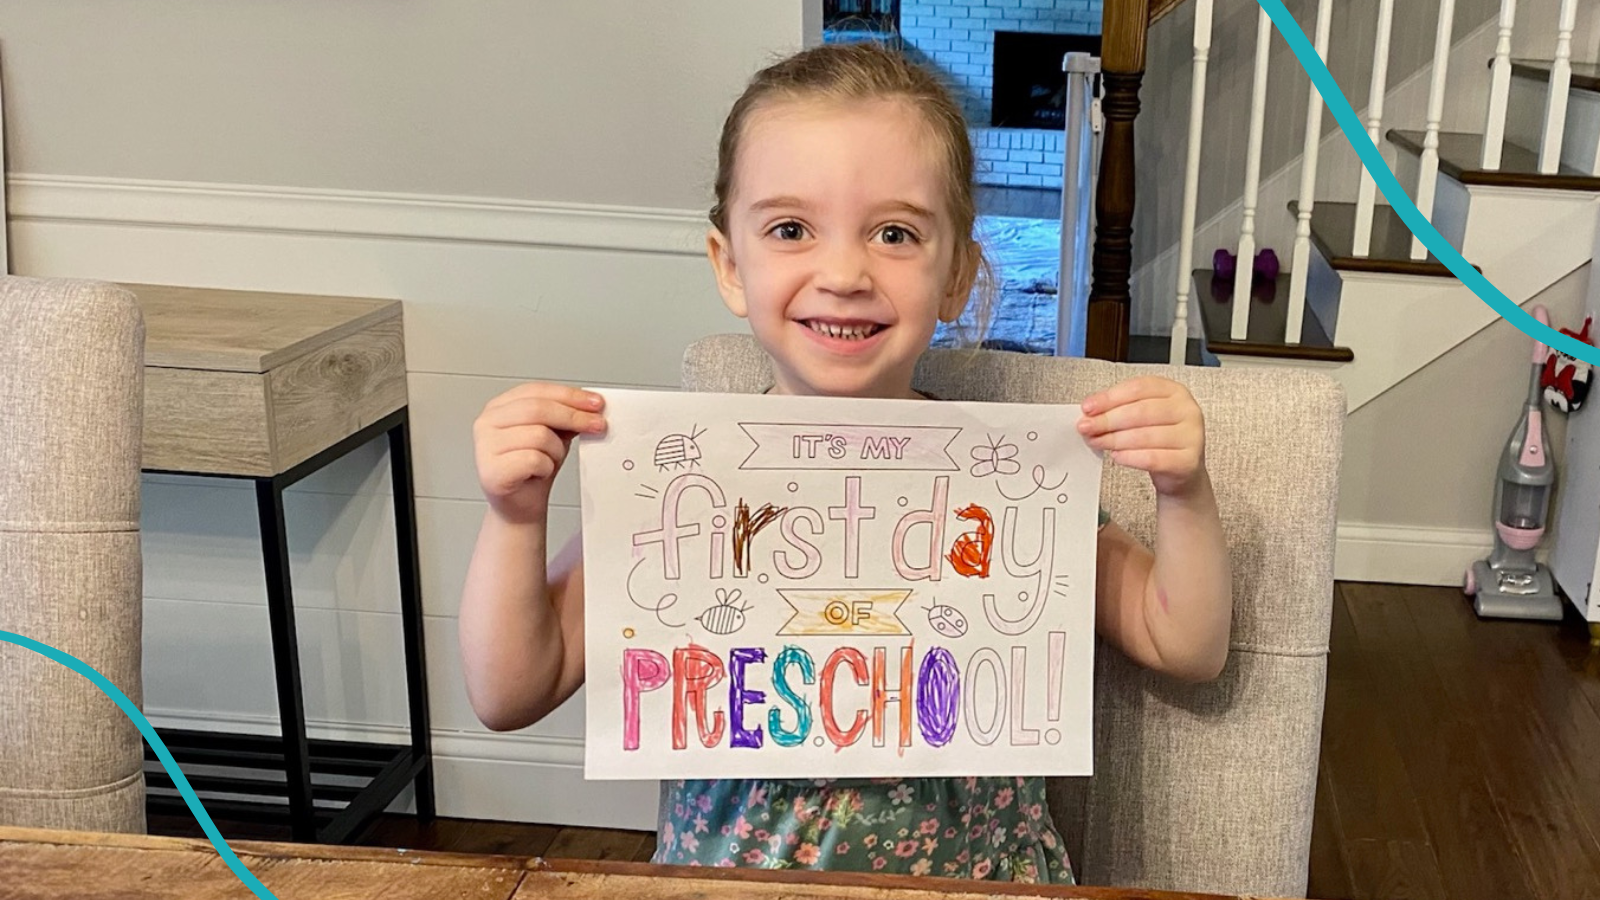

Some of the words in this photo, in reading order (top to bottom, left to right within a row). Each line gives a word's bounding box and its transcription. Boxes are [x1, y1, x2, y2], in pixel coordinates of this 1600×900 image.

[792, 433, 847, 460] IT'S
[860, 436, 912, 460] MY
[632, 472, 876, 580] first
[891, 475, 1056, 636] day
[823, 600, 874, 626] OF
[622, 630, 1067, 751] PRESCHOOL!
